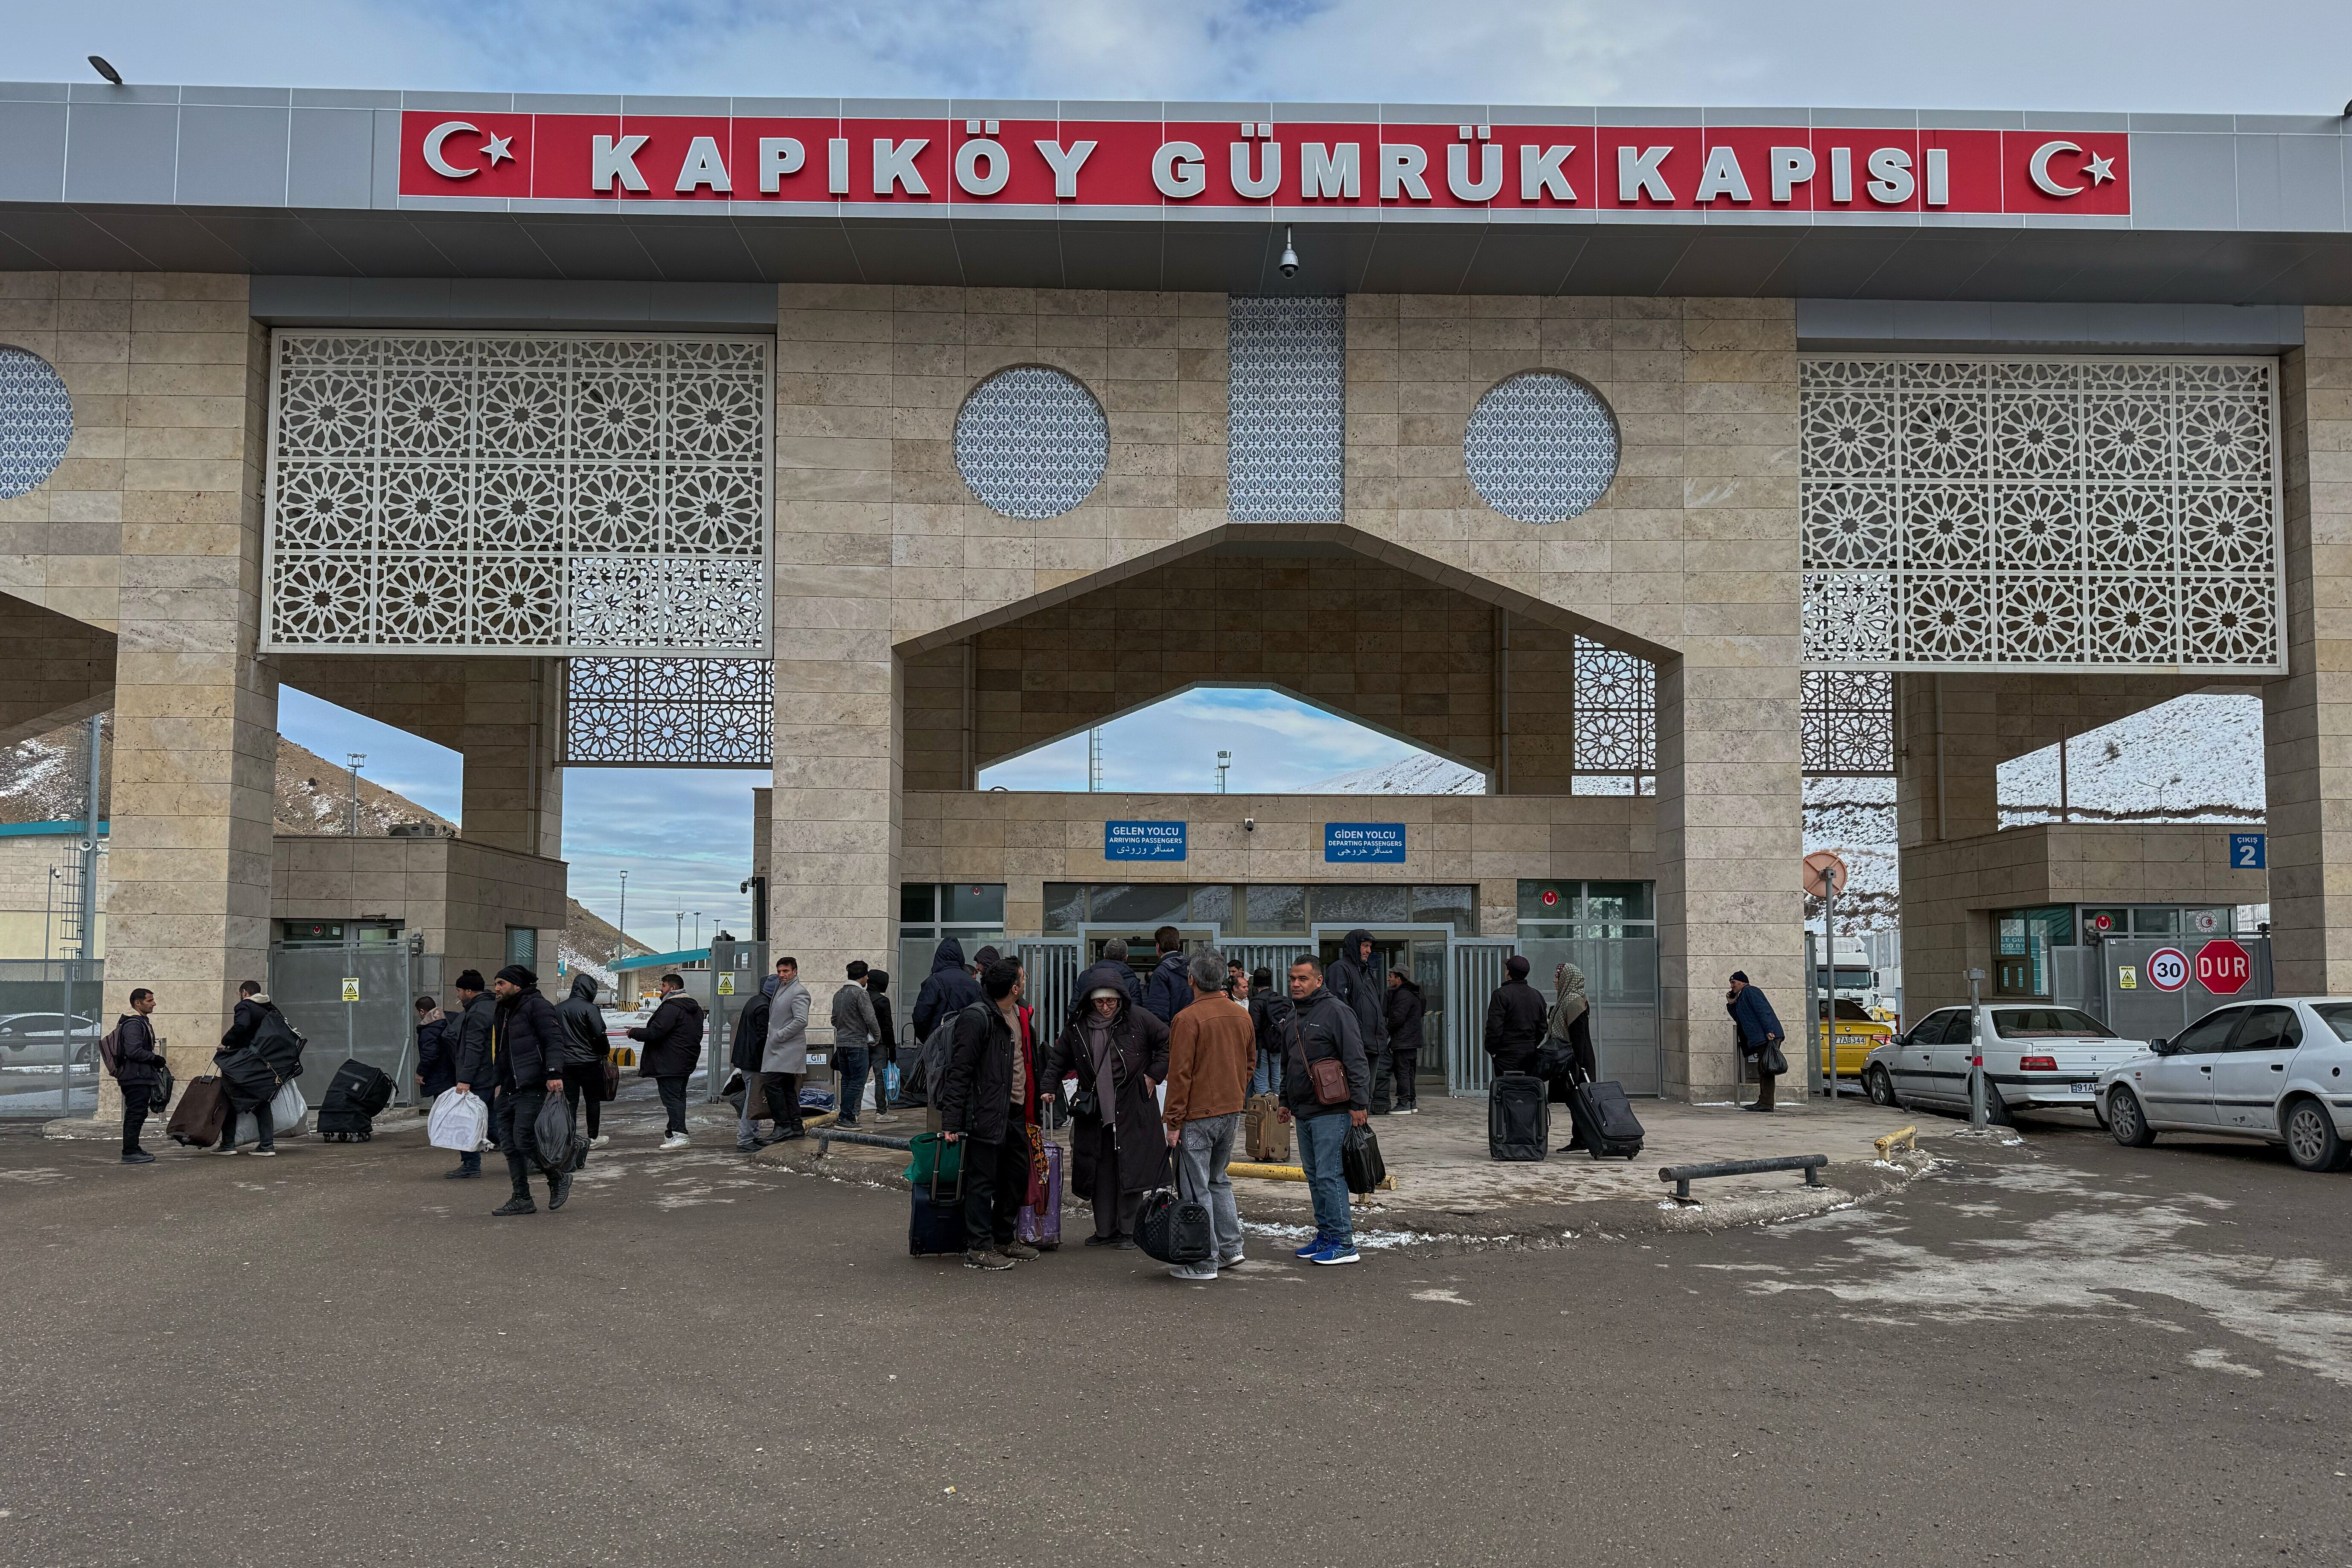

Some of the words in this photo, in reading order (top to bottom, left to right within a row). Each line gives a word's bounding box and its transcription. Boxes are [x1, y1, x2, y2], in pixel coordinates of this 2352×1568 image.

[592, 120, 1099, 197] KAPIKÖY
[1151, 123, 1578, 201] GÜMRÜK
[1617, 145, 1950, 206] KAPISI
[1113, 827, 1144, 835] GELEN
[1147, 827, 1179, 836] YOLCU
[1335, 829, 1363, 839] GİDEN
[1365, 831, 1396, 839] YOLCU
[1116, 845, 1147, 854] ورودی
[1150, 844, 1175, 855] مسافر
[1338, 847, 1367, 856] خروجی
[1370, 846, 1393, 856] مسافر
[2240, 845, 2256, 865] 2
[2157, 962, 2181, 978] 30
[2200, 957, 2246, 977] DUR
